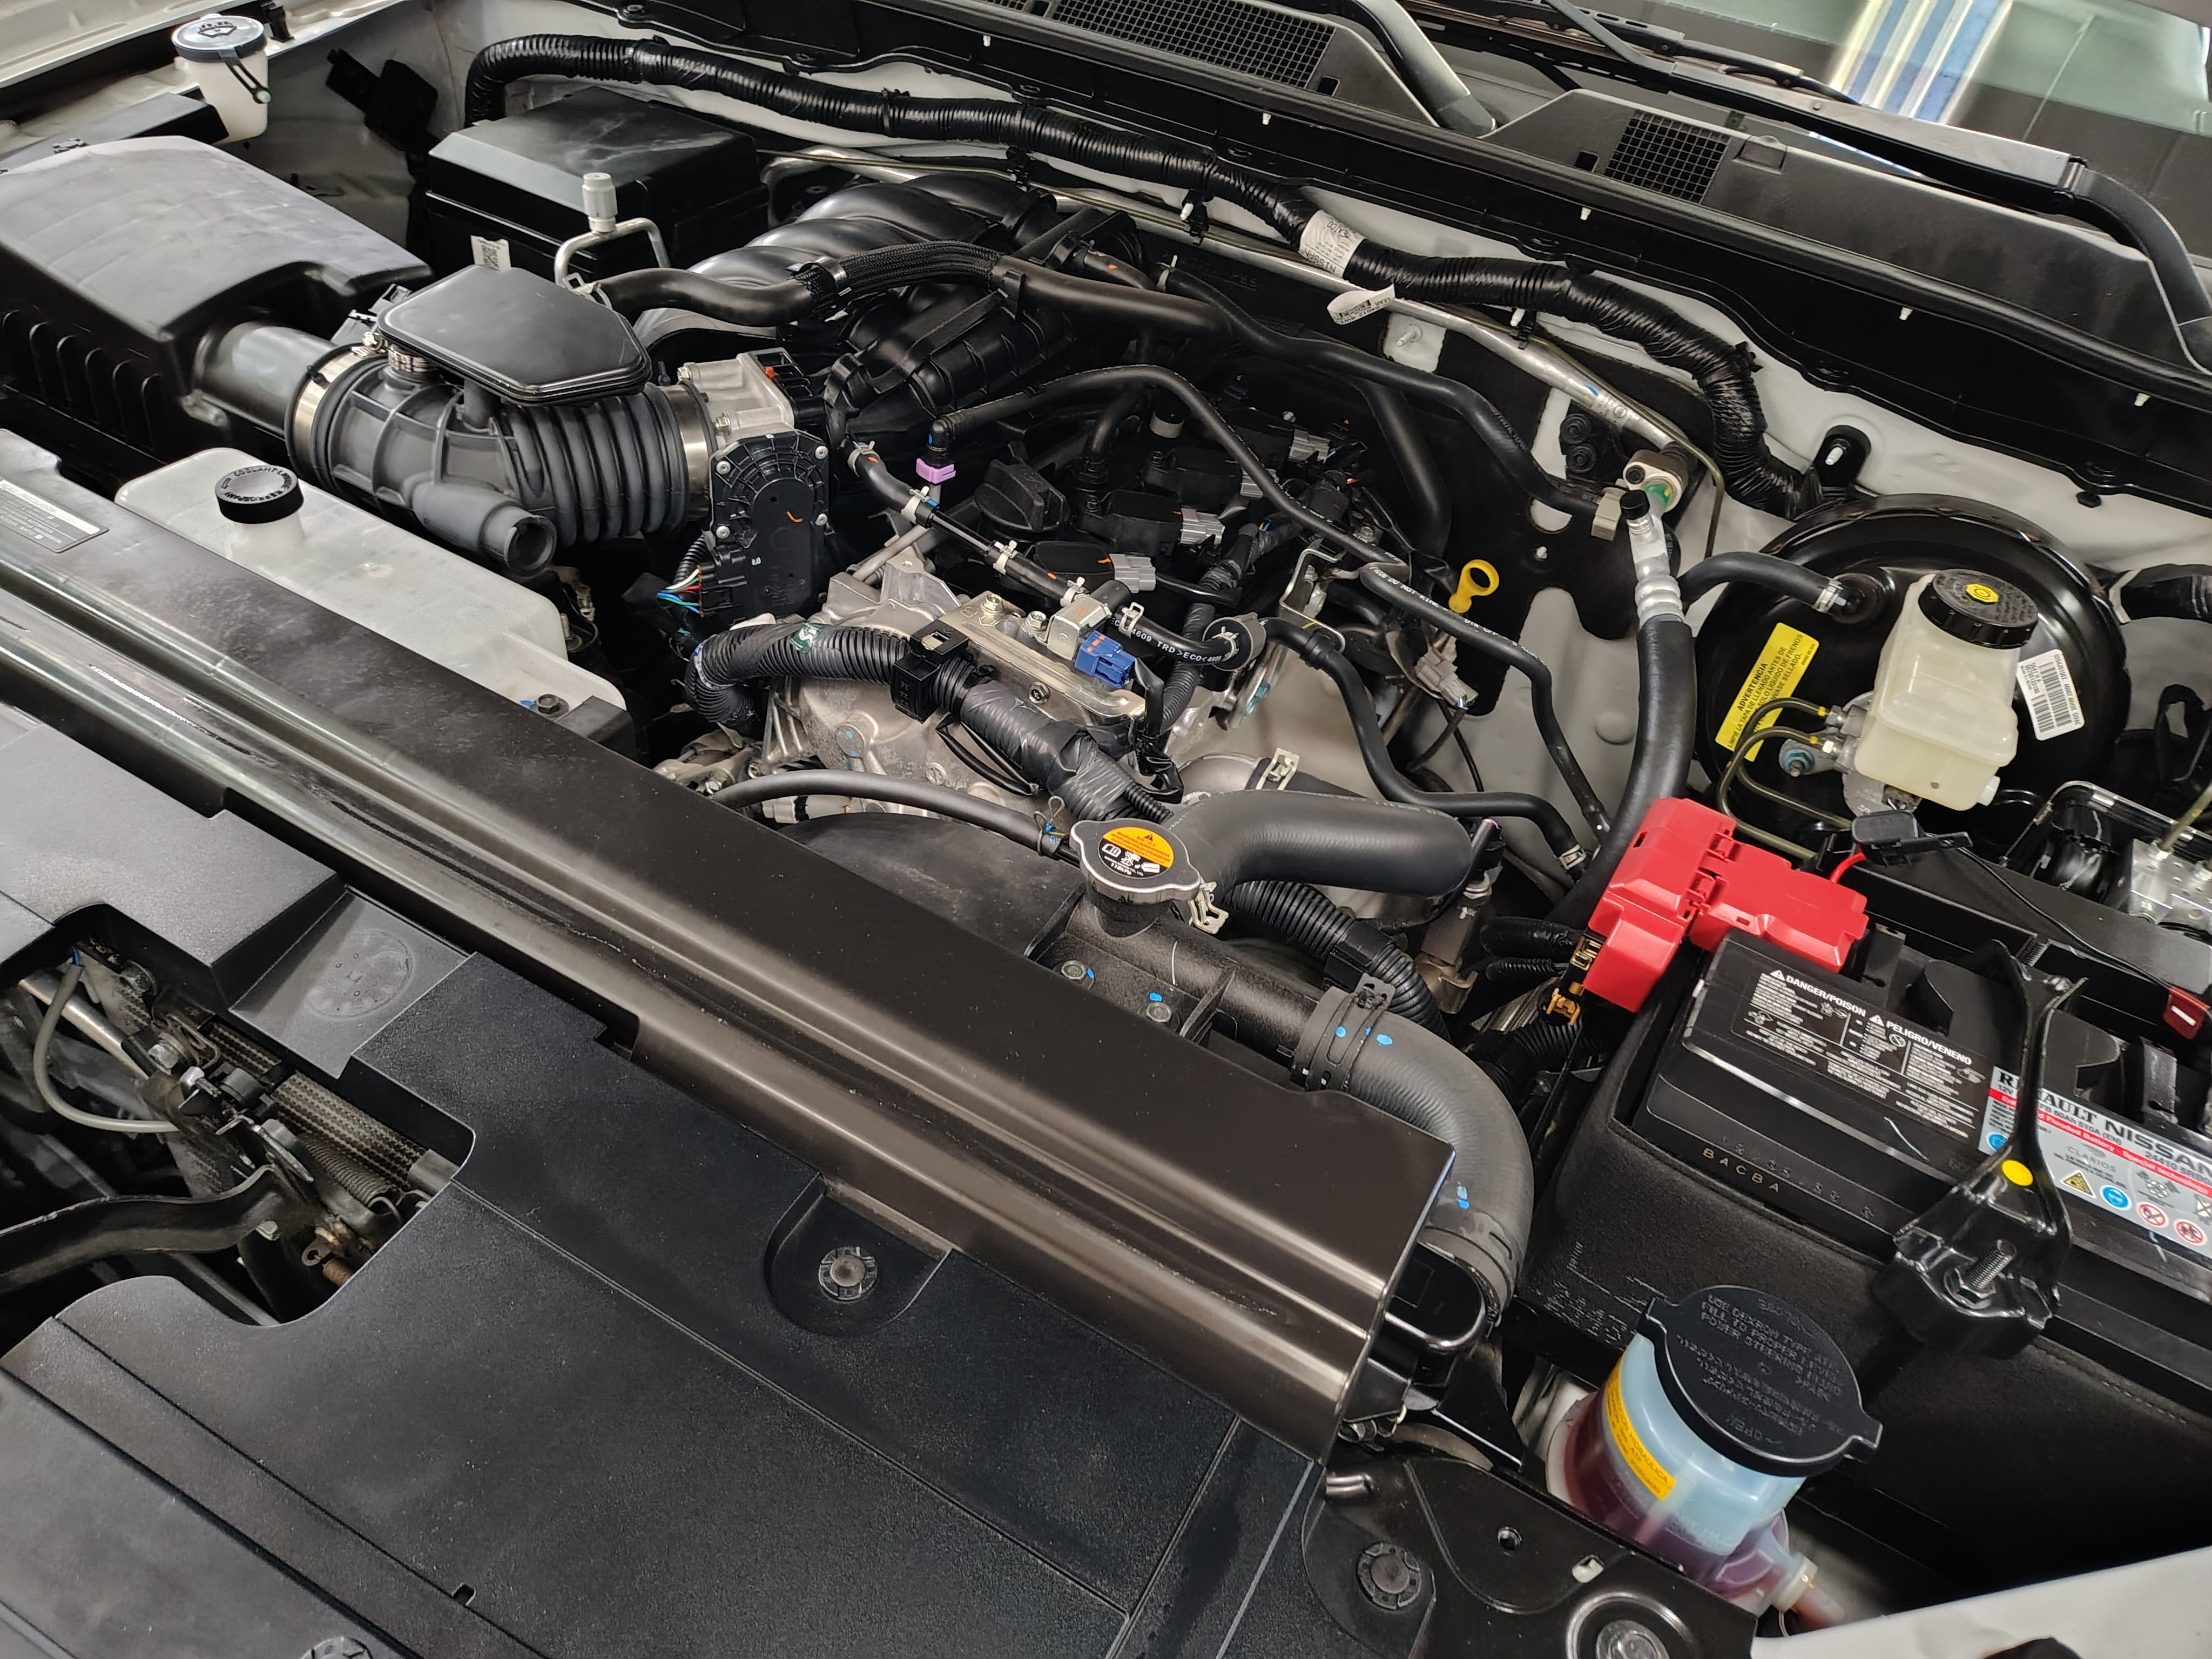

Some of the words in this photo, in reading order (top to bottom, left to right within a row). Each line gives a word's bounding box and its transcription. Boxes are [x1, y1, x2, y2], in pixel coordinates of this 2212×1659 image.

[1326, 220, 1351, 239] MEXICO
[1302, 248, 1337, 273] NISSAN
[233, 467, 278, 477] COOLANT
[1784, 632, 1803, 659] FRENOS
[1780, 657, 1789, 667] DE
[1736, 661, 1768, 712] ADVERTENCIA
[1766, 666, 1784, 692] LIQUIDO
[1727, 730, 1739, 748] LIMPIE
[1735, 722, 1743, 731] LA
[1739, 707, 1751, 724] TAPA
[1746, 700, 1755, 710] DE
[1751, 673, 1770, 702] LLENADO
[1766, 654, 1781, 675] ANTES
[1777, 645, 1786, 656] DE
[1784, 975, 1867, 1017] DANGER/POISON
[1885, 1020, 1973, 1065] PELIGRO/VENENO
[2081, 1132, 2116, 1152] Battery
[1701, 1147, 1781, 1193] BACBA
[2066, 1145, 2117, 1172] CLARIOS
[2143, 1150, 2179, 1171] 24410
[1700, 1300, 1728, 1321] FILL
[1750, 1328, 1798, 1361] PROPER
[1730, 1306, 1781, 1340] DEXRON
[1699, 1310, 1742, 1340] POWER
[1743, 1335, 1804, 1375] STEERING
[1725, 1413, 1765, 1443] OPEN
